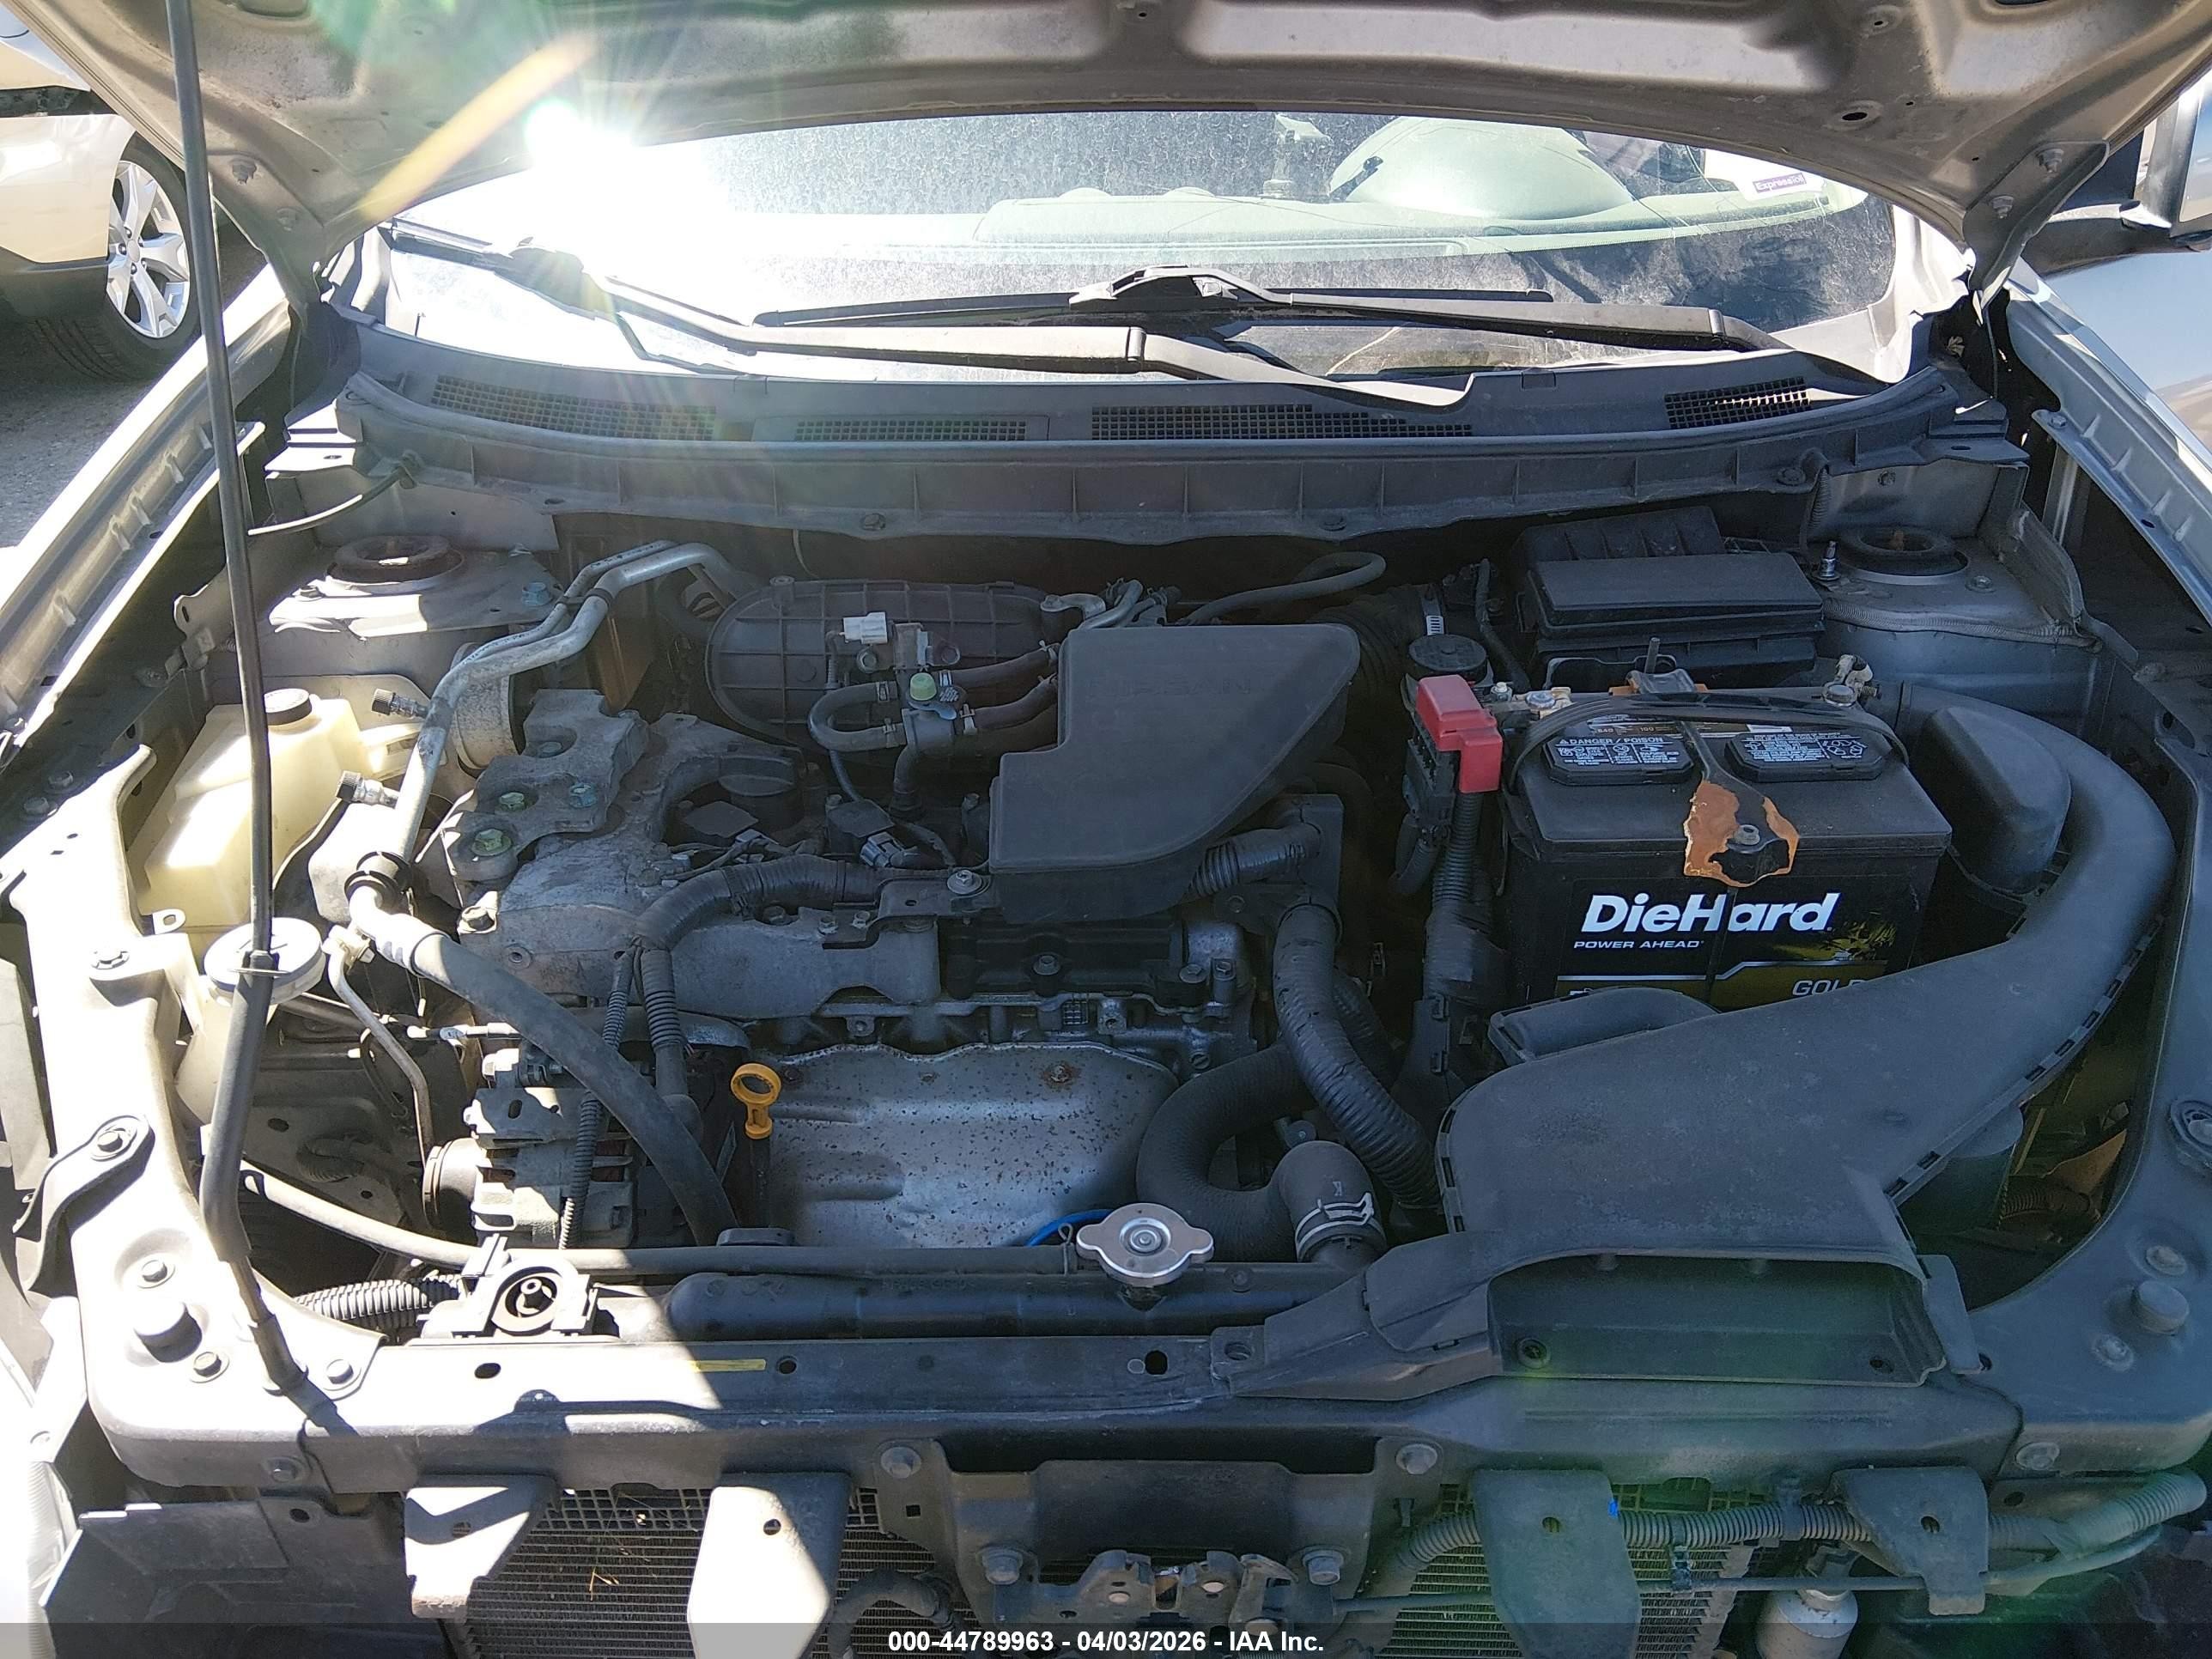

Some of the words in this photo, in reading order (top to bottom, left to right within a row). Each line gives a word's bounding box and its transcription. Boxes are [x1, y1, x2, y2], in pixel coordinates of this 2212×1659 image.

[1581, 892, 1842, 933] DieHard
[1573, 940, 1634, 949] POWER
[1640, 940, 1700, 949] AHEAD
